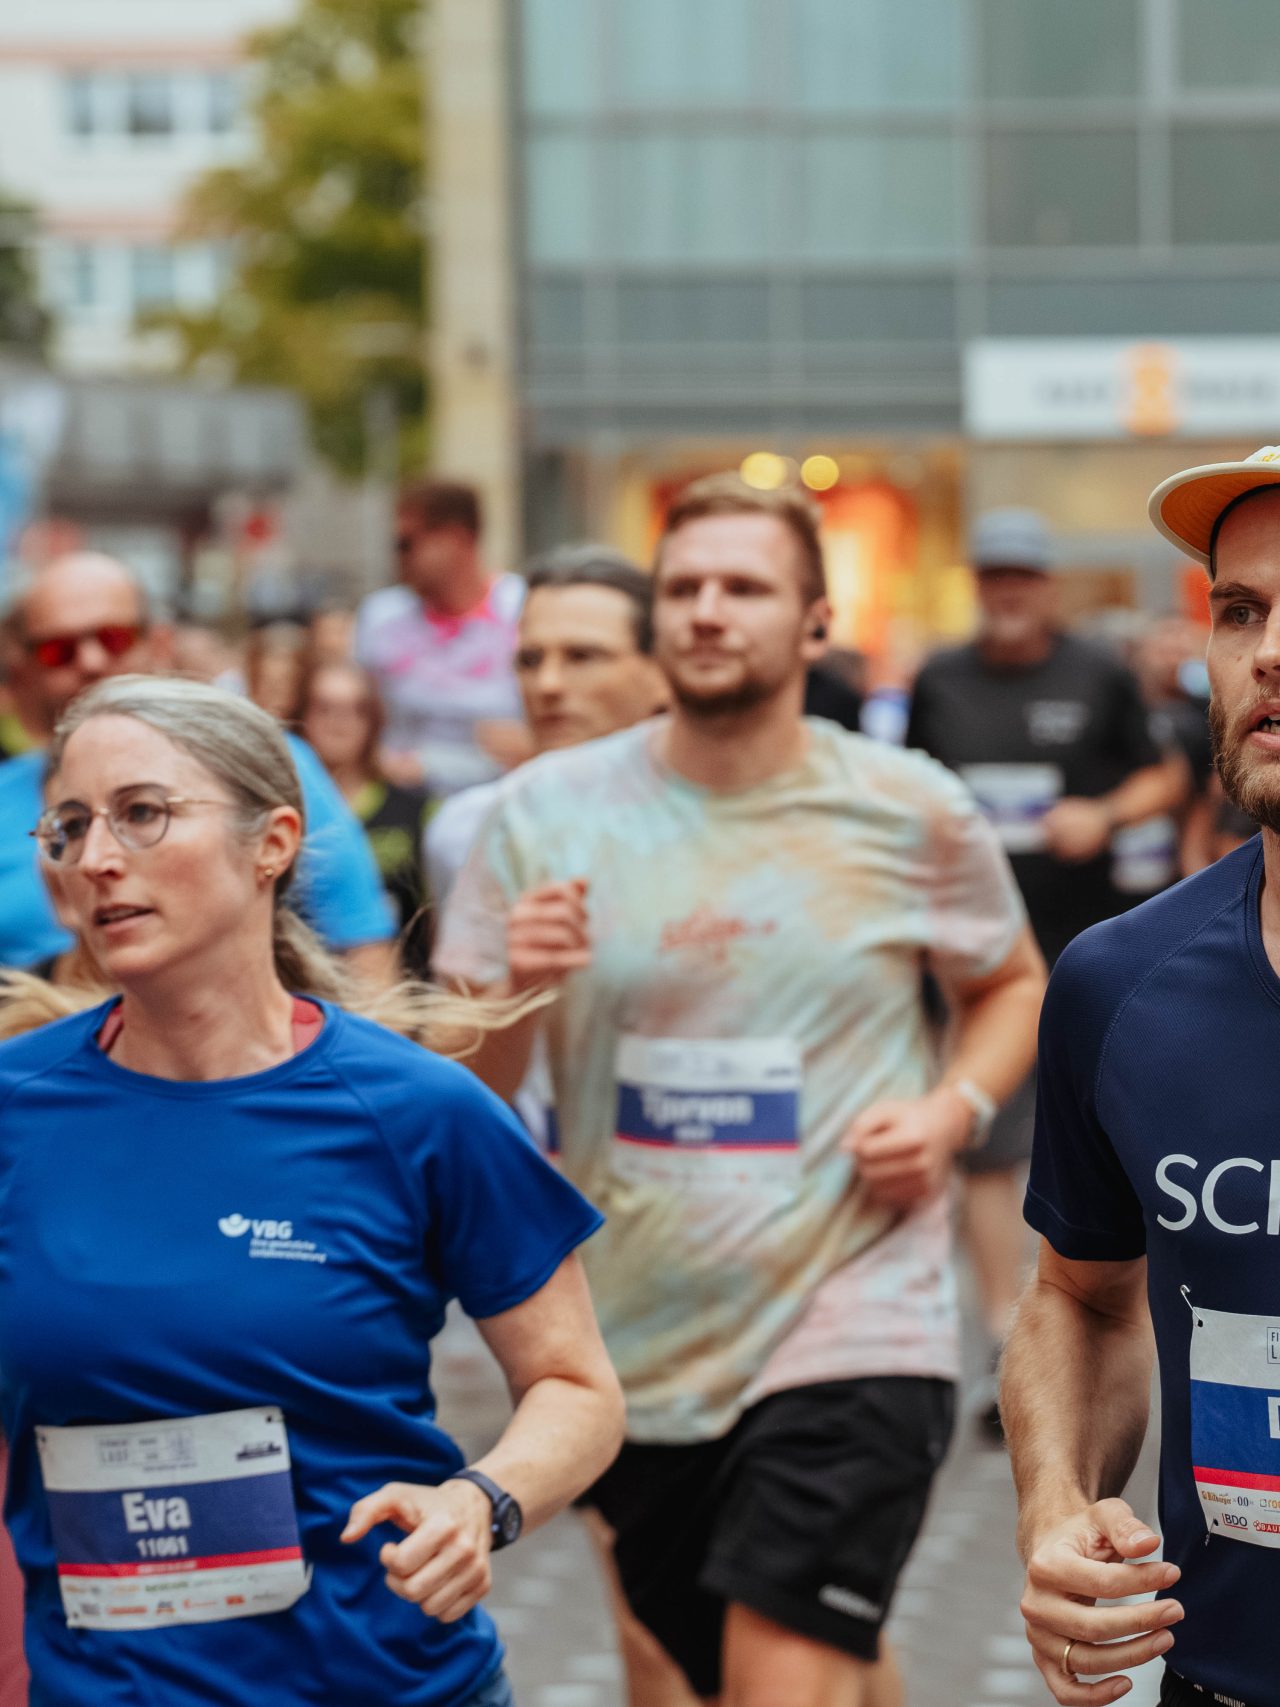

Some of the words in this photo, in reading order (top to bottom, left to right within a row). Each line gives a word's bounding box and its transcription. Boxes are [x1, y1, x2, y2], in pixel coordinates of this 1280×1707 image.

[251, 1219, 293, 1240] VBG
[121, 1491, 192, 1534] Eva
[1224, 1513, 1248, 1527] BDO
